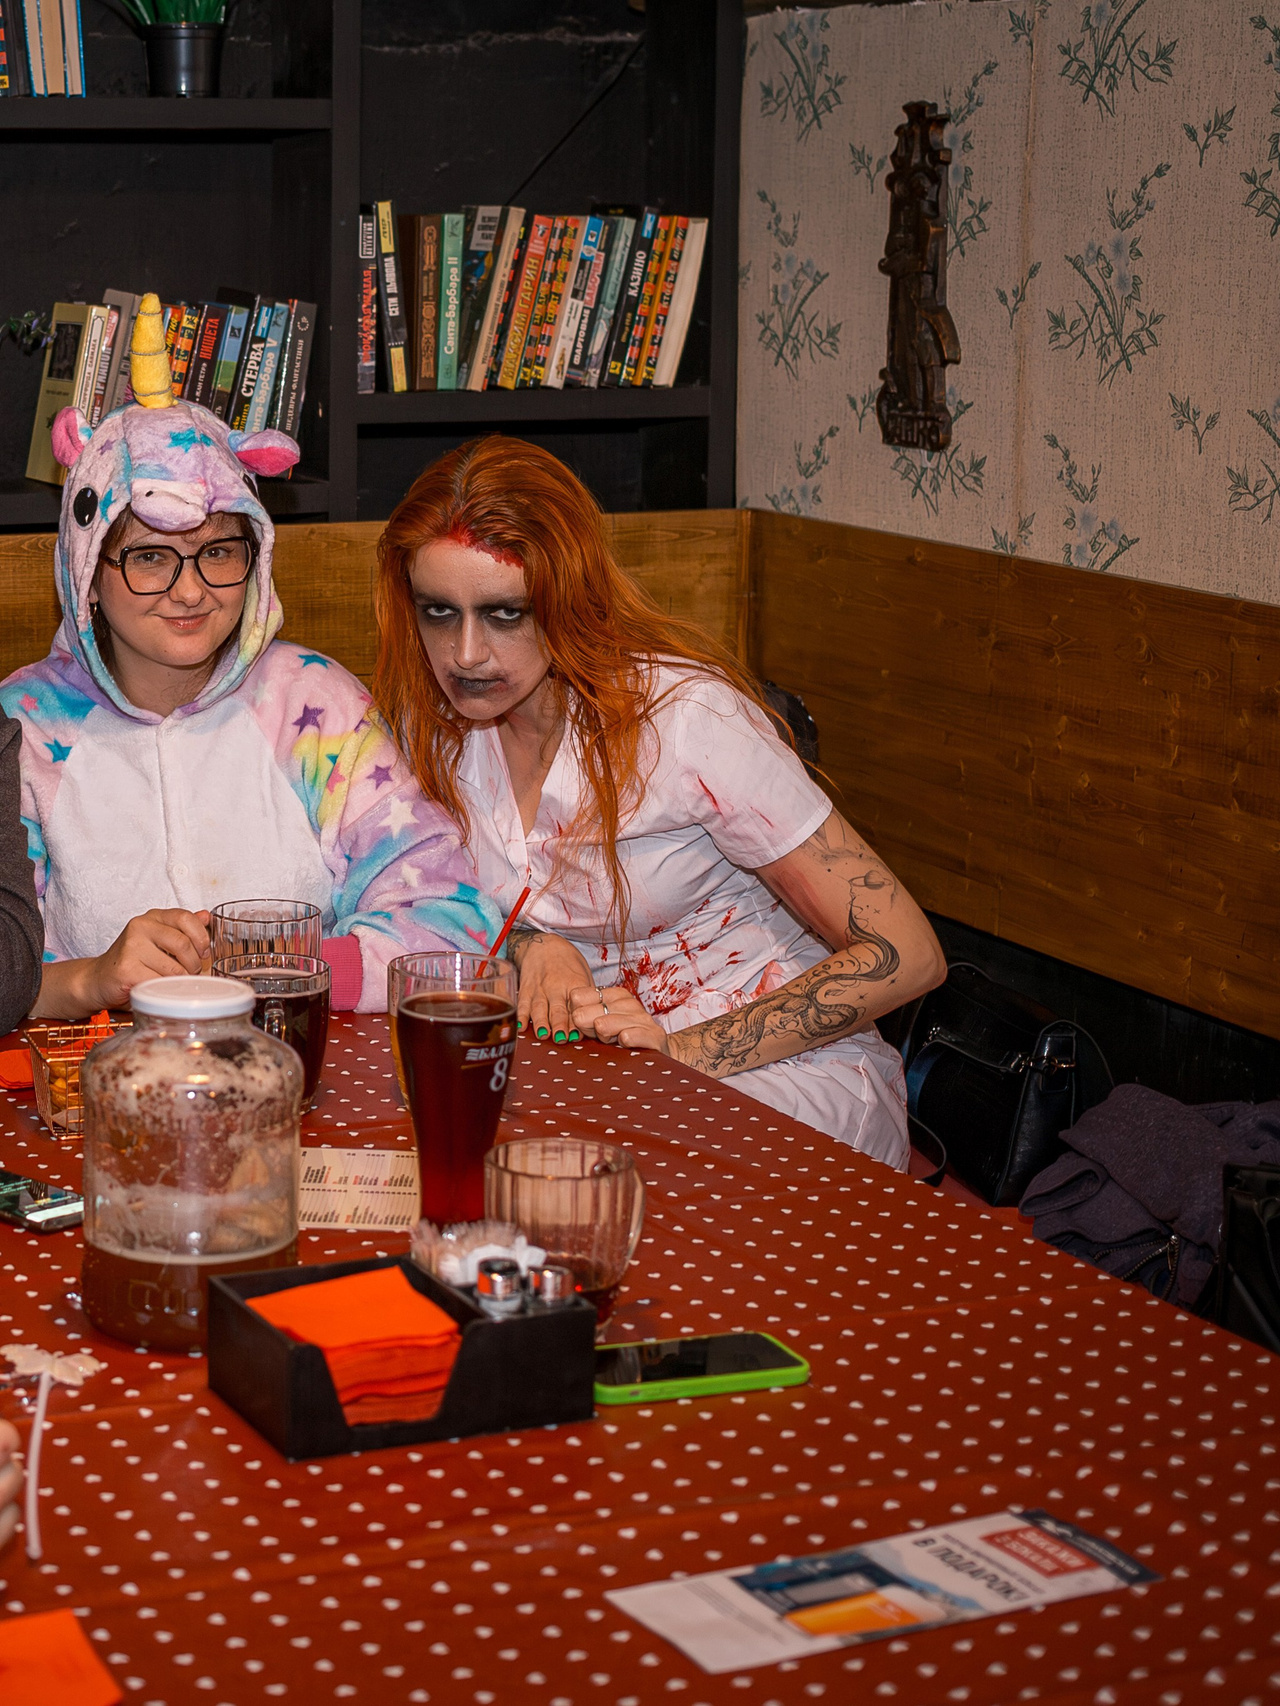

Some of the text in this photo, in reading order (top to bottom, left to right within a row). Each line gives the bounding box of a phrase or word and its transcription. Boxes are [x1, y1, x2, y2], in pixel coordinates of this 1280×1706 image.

[519, 257, 538, 308] ГАРИН
[628, 249, 645, 296] КАЗИНО
[388, 297, 398, 315] СЕТИ
[444, 267, 459, 353] Санта-Барбара
[199, 316, 219, 359] НИЩЕТА
[240, 340, 265, 397] СТЕРВА
[249, 351, 275, 432] анта-Барбара
[266, 337, 277, 347] V
[285, 339, 305, 431] ШЕДЕВРЫ ФАНТАСТИКИ
[490, 1057, 508, 1091] 8
[910, 1536, 937, 1554] В
